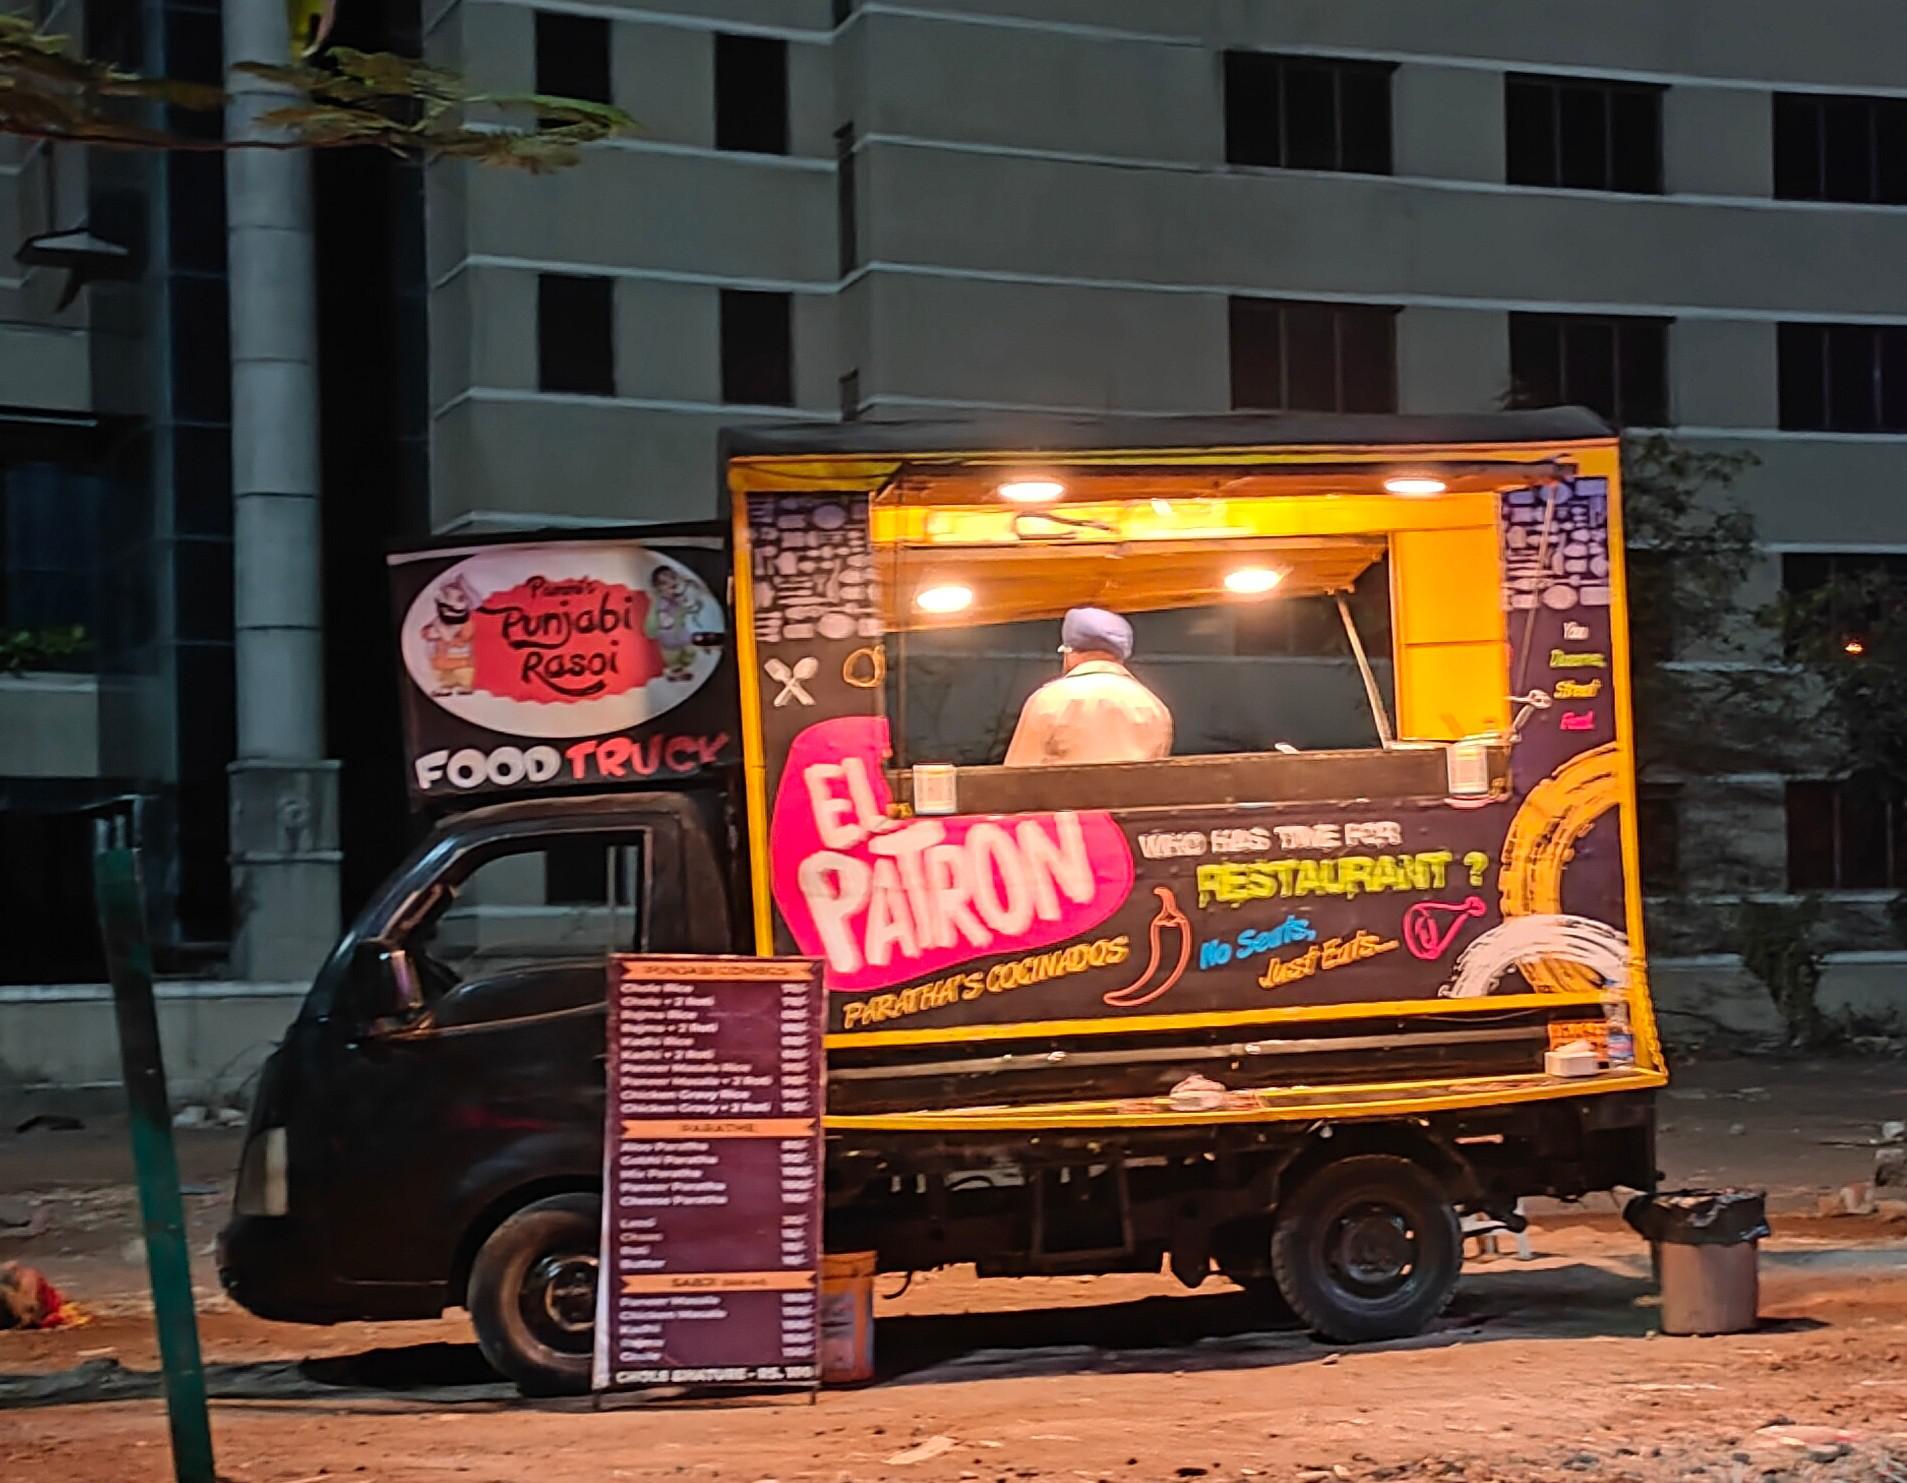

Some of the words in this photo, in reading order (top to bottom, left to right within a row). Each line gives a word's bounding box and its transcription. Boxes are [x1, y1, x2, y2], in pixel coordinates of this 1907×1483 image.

[478, 597, 632, 650] Punjabi
[520, 640, 620, 696] Rasoi
[415, 746, 561, 789] FOOD
[565, 732, 730, 780] TRUCK
[803, 756, 897, 849] EL
[1138, 831, 1208, 859] WHO
[1211, 826, 1272, 853] HAS
[1345, 820, 1402, 848] FOR
[799, 811, 1096, 974] PATRON
[1197, 849, 1453, 909] RESTAURANT
[1463, 850, 1490, 888] ?
[986, 935, 1131, 993] COCINADOS
[1200, 938, 1233, 970] No
[1259, 945, 1321, 989] Just
